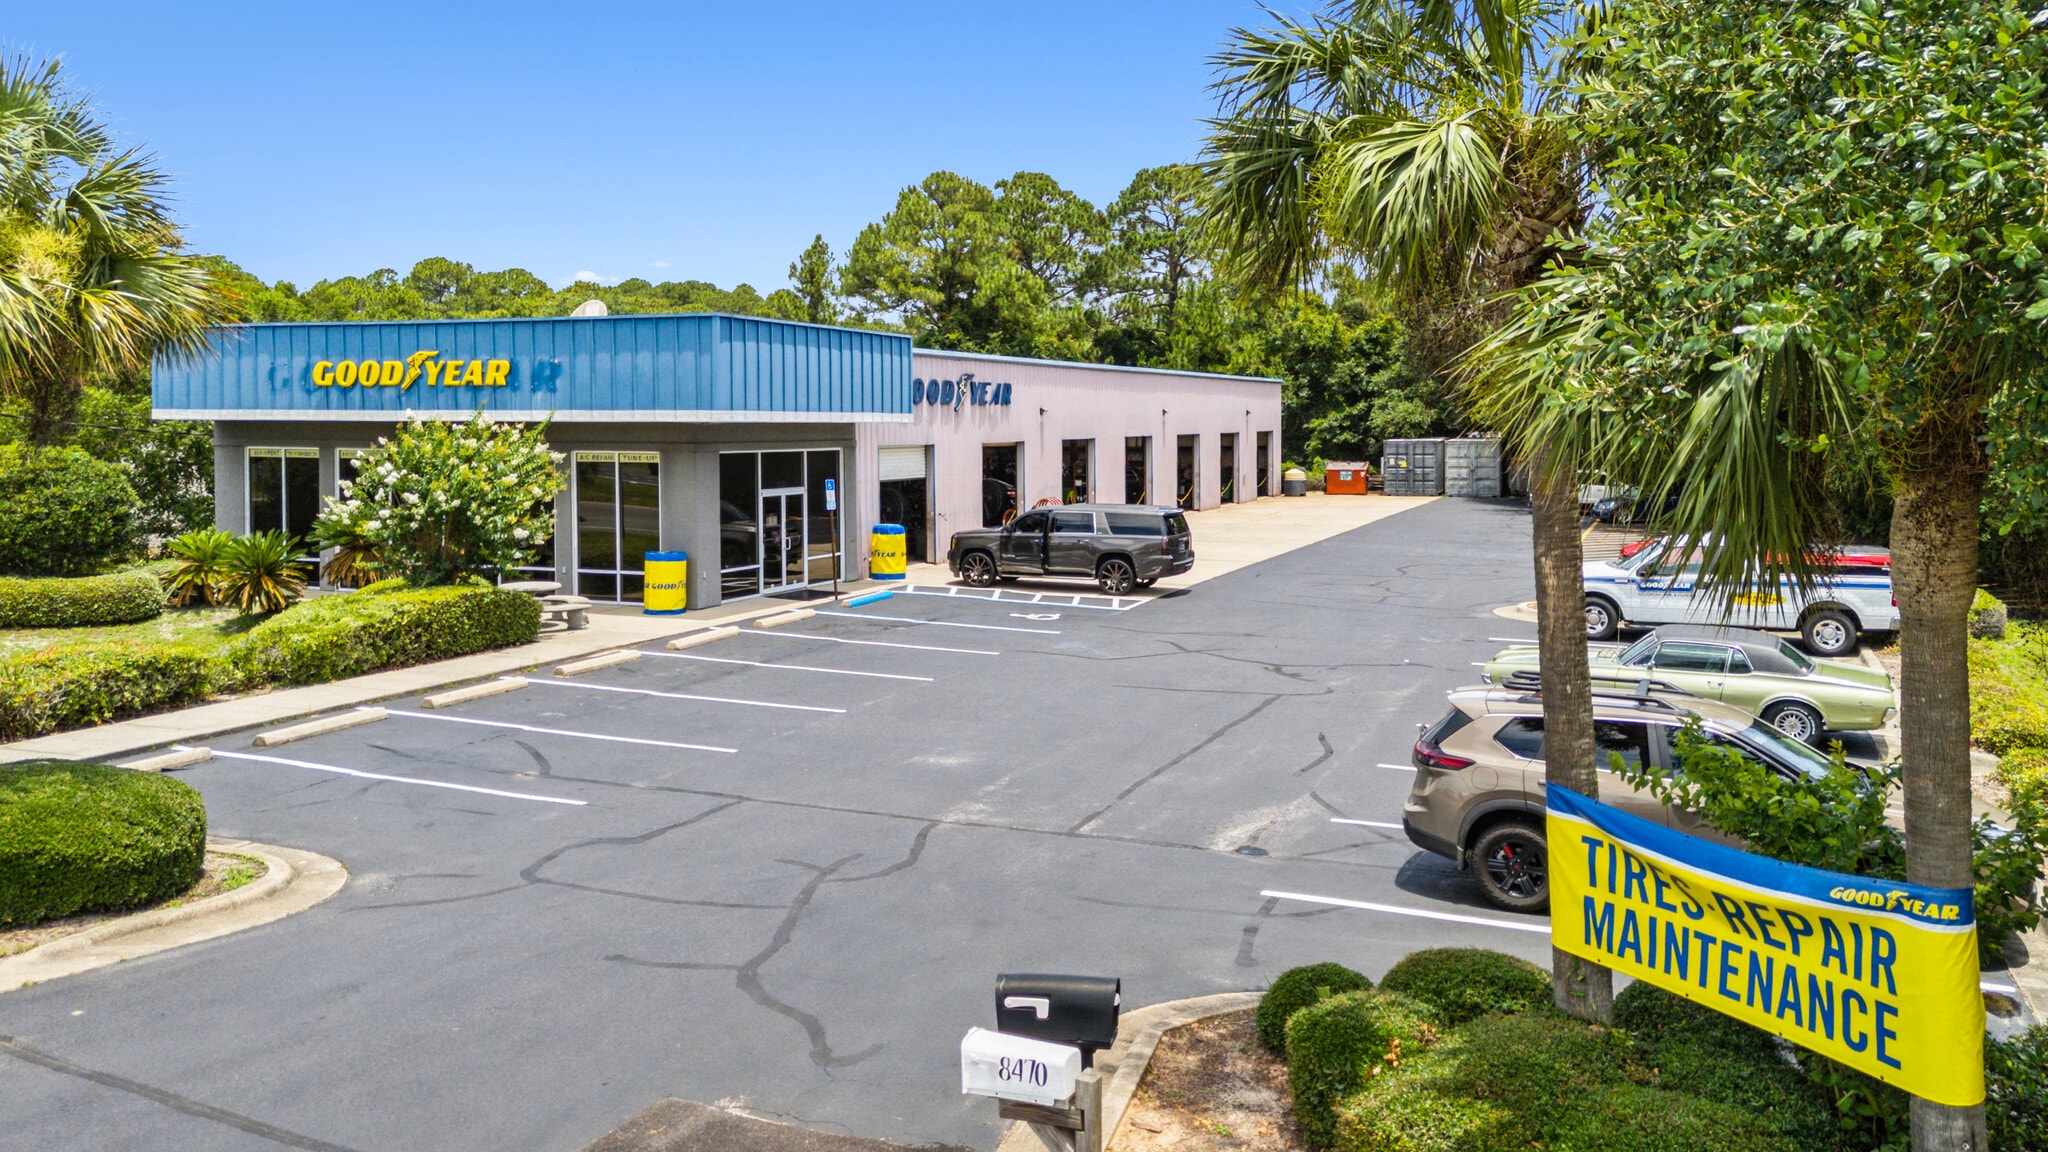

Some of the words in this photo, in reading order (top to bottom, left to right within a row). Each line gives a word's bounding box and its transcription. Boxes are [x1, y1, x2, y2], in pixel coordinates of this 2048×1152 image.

[312, 351, 511, 391] GOODYEAR
[913, 374, 1013, 412] OODYEAR
[1829, 886, 1960, 920] GOODYEAR
[1583, 895, 1902, 1070] MAINTENANCE
[999, 1056, 1048, 1087] 8470
